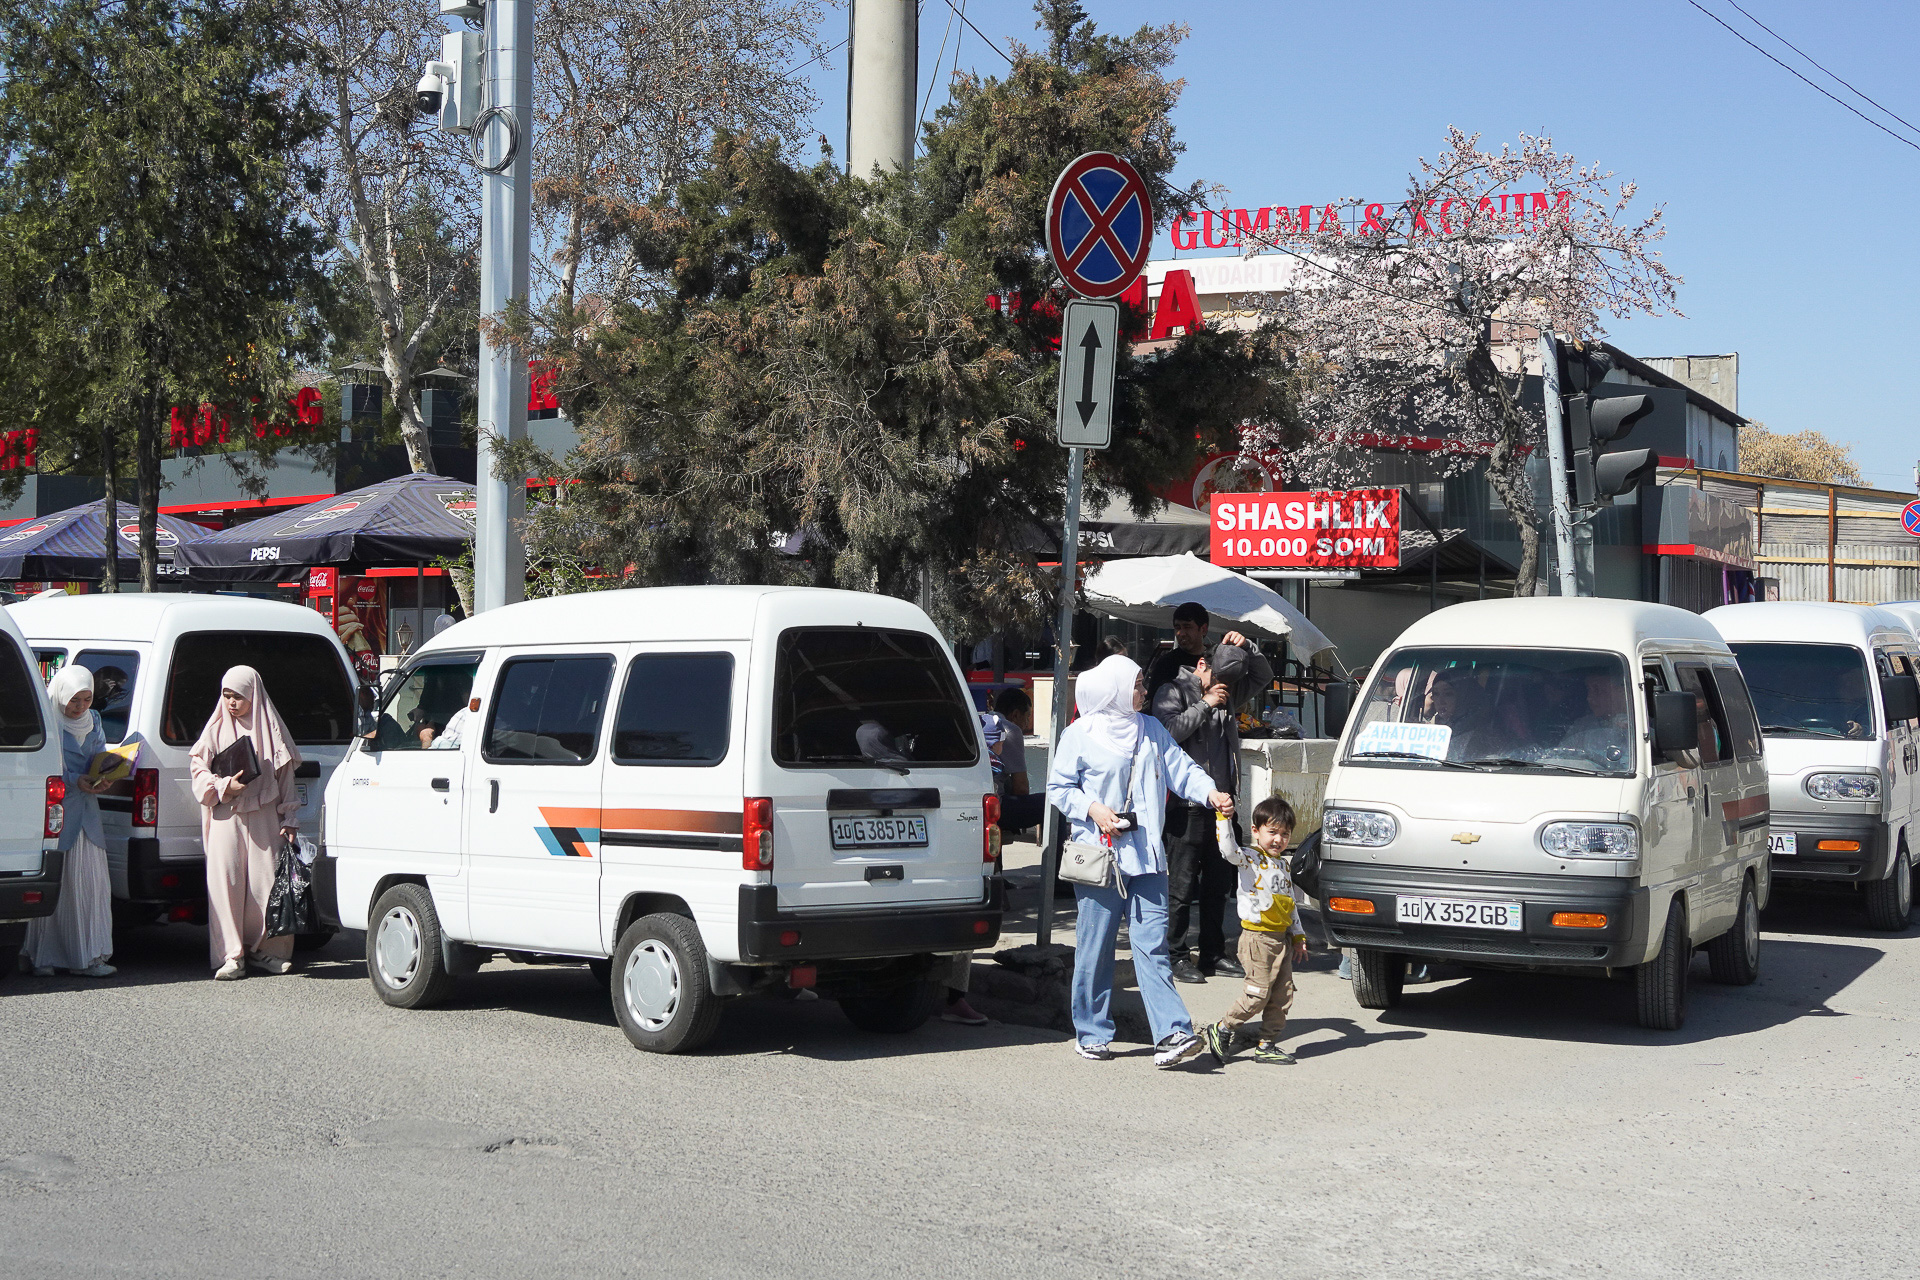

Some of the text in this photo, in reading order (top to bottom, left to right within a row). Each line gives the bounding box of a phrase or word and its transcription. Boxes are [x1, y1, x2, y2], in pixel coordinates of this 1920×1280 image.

[1190, 262, 1263, 288] AYDARI
[1216, 500, 1392, 531] SHASHLIK
[1077, 530, 1115, 548] EPSI
[1222, 538, 1307, 557] 10.000
[250, 547, 280, 561] PEPSI
[156, 563, 190, 575] EPSI
[1361, 725, 1448, 742] АНАТОРИЯ
[1401, 903, 1420, 918] 10
